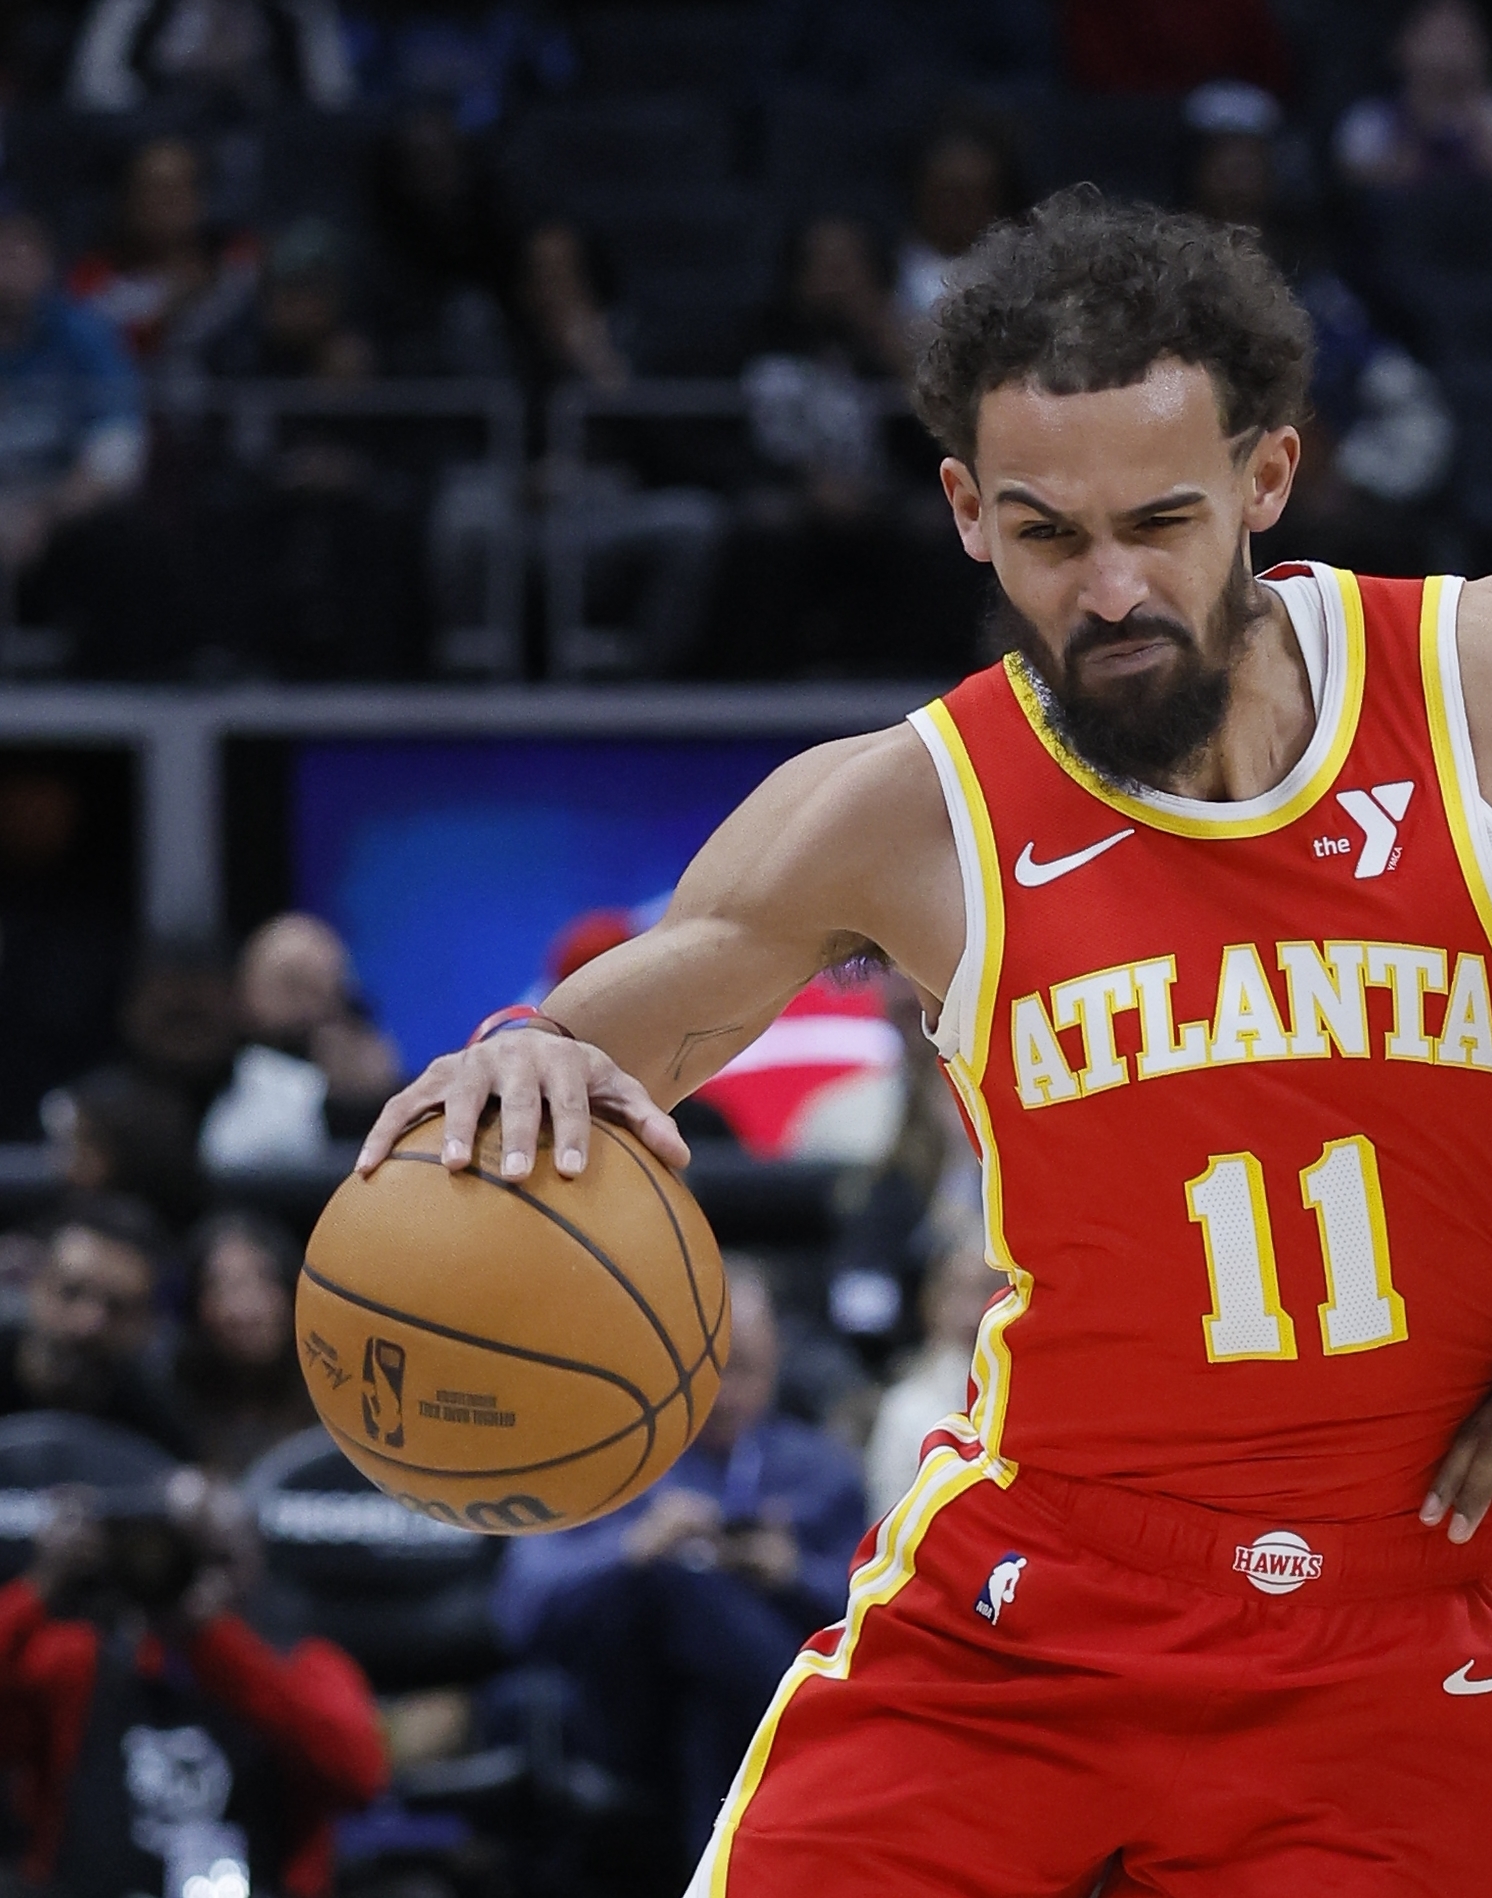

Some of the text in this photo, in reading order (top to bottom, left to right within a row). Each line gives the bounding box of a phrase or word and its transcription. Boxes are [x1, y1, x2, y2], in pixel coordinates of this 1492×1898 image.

[1313, 781, 1415, 879] the Y
[1387, 847, 1403, 872] YMCA
[1184, 1134, 1409, 1364] 11
[1234, 1548, 1322, 1578] HAWKS
